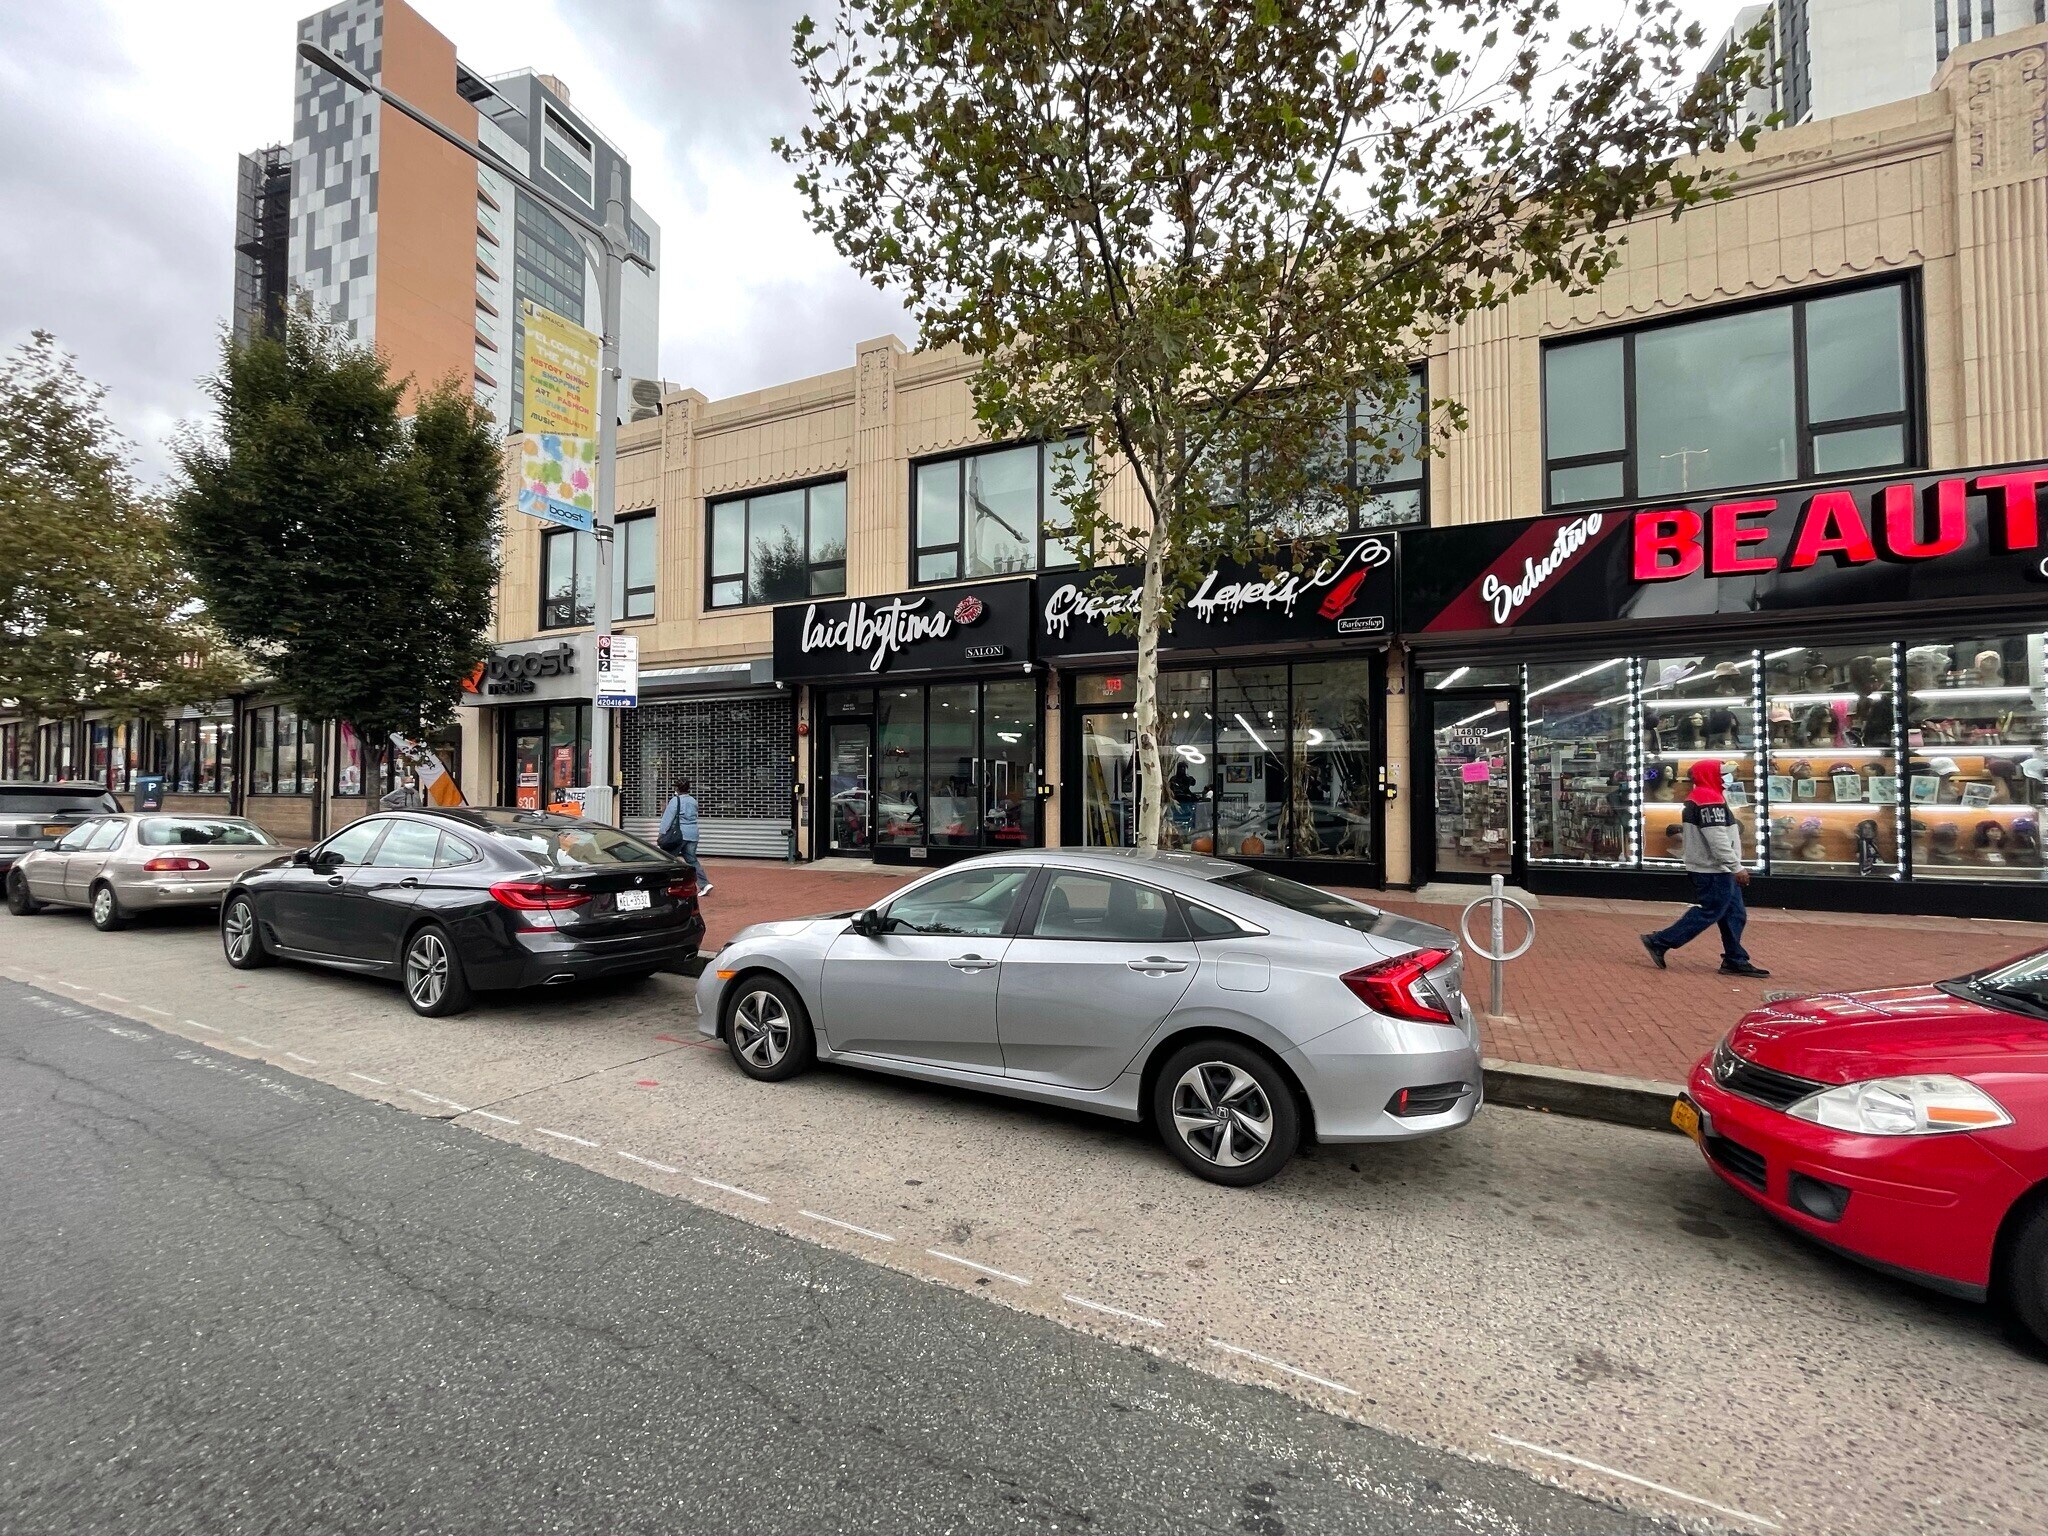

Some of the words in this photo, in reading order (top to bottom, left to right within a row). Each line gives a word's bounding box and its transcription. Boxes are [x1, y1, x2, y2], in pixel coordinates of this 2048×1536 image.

[536, 311, 565, 329] JAMAICA
[536, 344, 560, 364] THE
[530, 356, 563, 377] HISTORY
[565, 372, 590, 390] DINING
[541, 370, 581, 394] SHOPPING
[529, 375, 561, 395] CINEMA
[535, 387, 551, 399] ART
[557, 396, 590, 416] FASHION
[530, 412, 556, 428] MUSIC
[545, 409, 589, 433] COMMUNITY
[549, 504, 585, 524] boost
[1482, 512, 1603, 625] Seductive
[1044, 584, 1168, 639] Creat
[1188, 569, 1301, 624] Levels
[1340, 617, 1382, 630] Barbershop
[488, 642, 575, 680] boost
[966, 646, 1002, 658] SALON
[601, 661, 609, 672] 2
[1476, 728, 1487, 736] 02
[148, 782, 157, 792] P
[518, 797, 536, 810] $30
